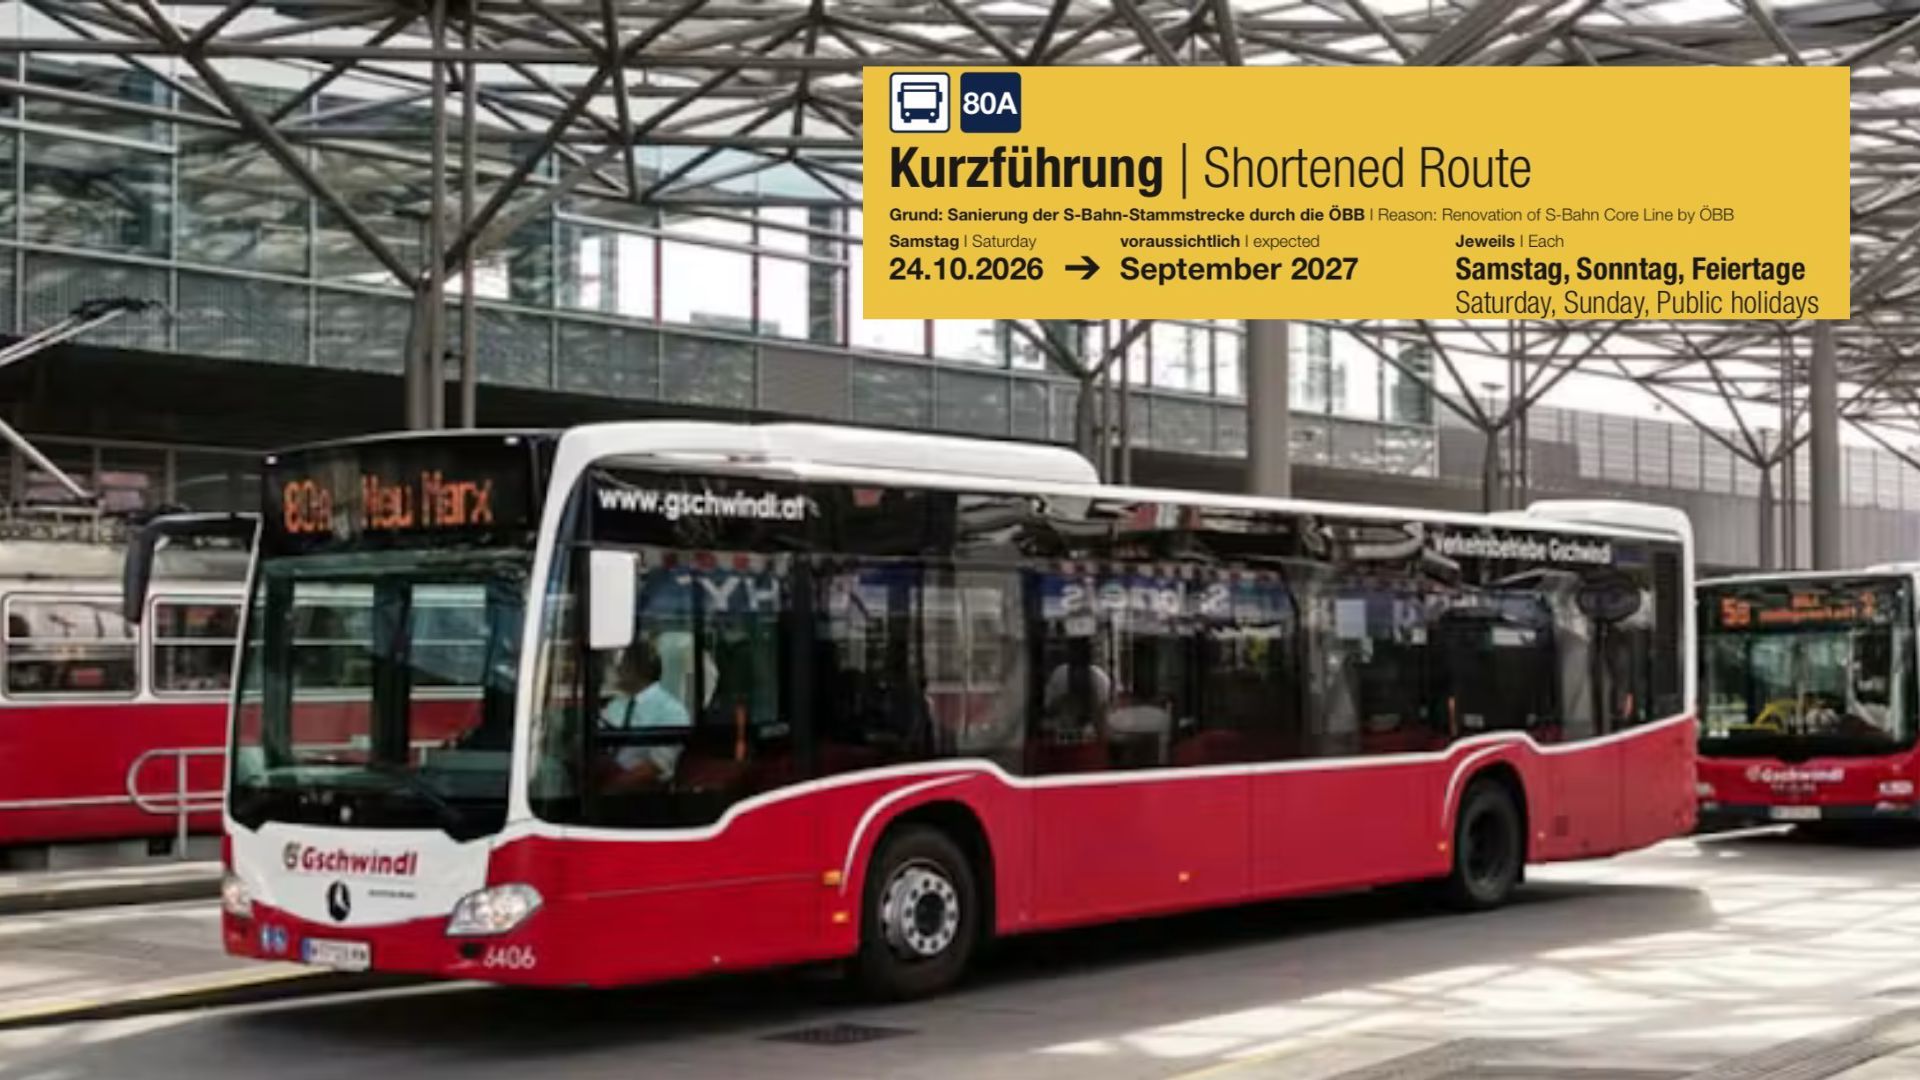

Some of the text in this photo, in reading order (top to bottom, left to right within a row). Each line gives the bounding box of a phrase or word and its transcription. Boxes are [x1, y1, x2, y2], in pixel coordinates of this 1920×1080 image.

[597, 486, 805, 521] www.gschwindl.at
[301, 845, 418, 875] Gschwindl
[483, 944, 536, 970] 6406
